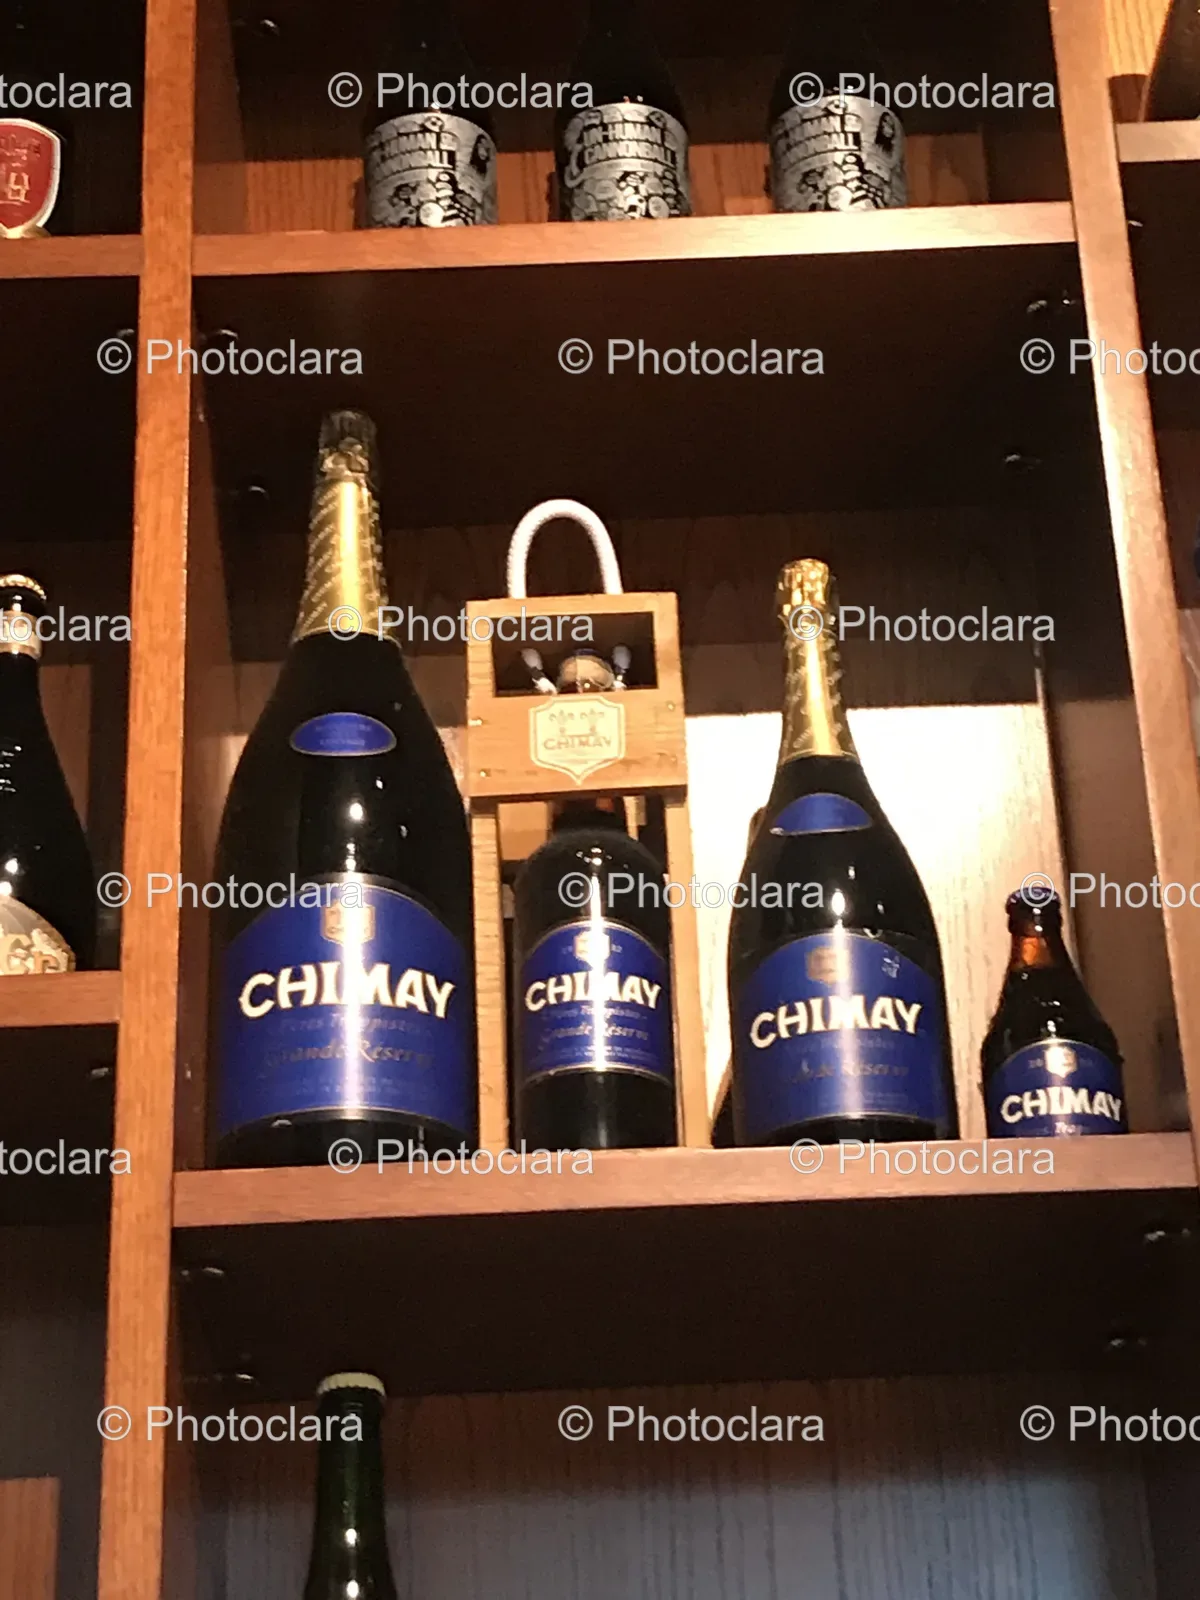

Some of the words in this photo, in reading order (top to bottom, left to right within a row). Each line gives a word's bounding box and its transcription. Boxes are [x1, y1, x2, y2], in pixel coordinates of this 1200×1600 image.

[542, 735, 612, 751] CHIMAY
[238, 960, 457, 1019] CHIMAY
[525, 970, 662, 1012] CHIMAY
[749, 994, 923, 1049] CHIMAY
[1000, 1086, 1122, 1123] CHIMAY
